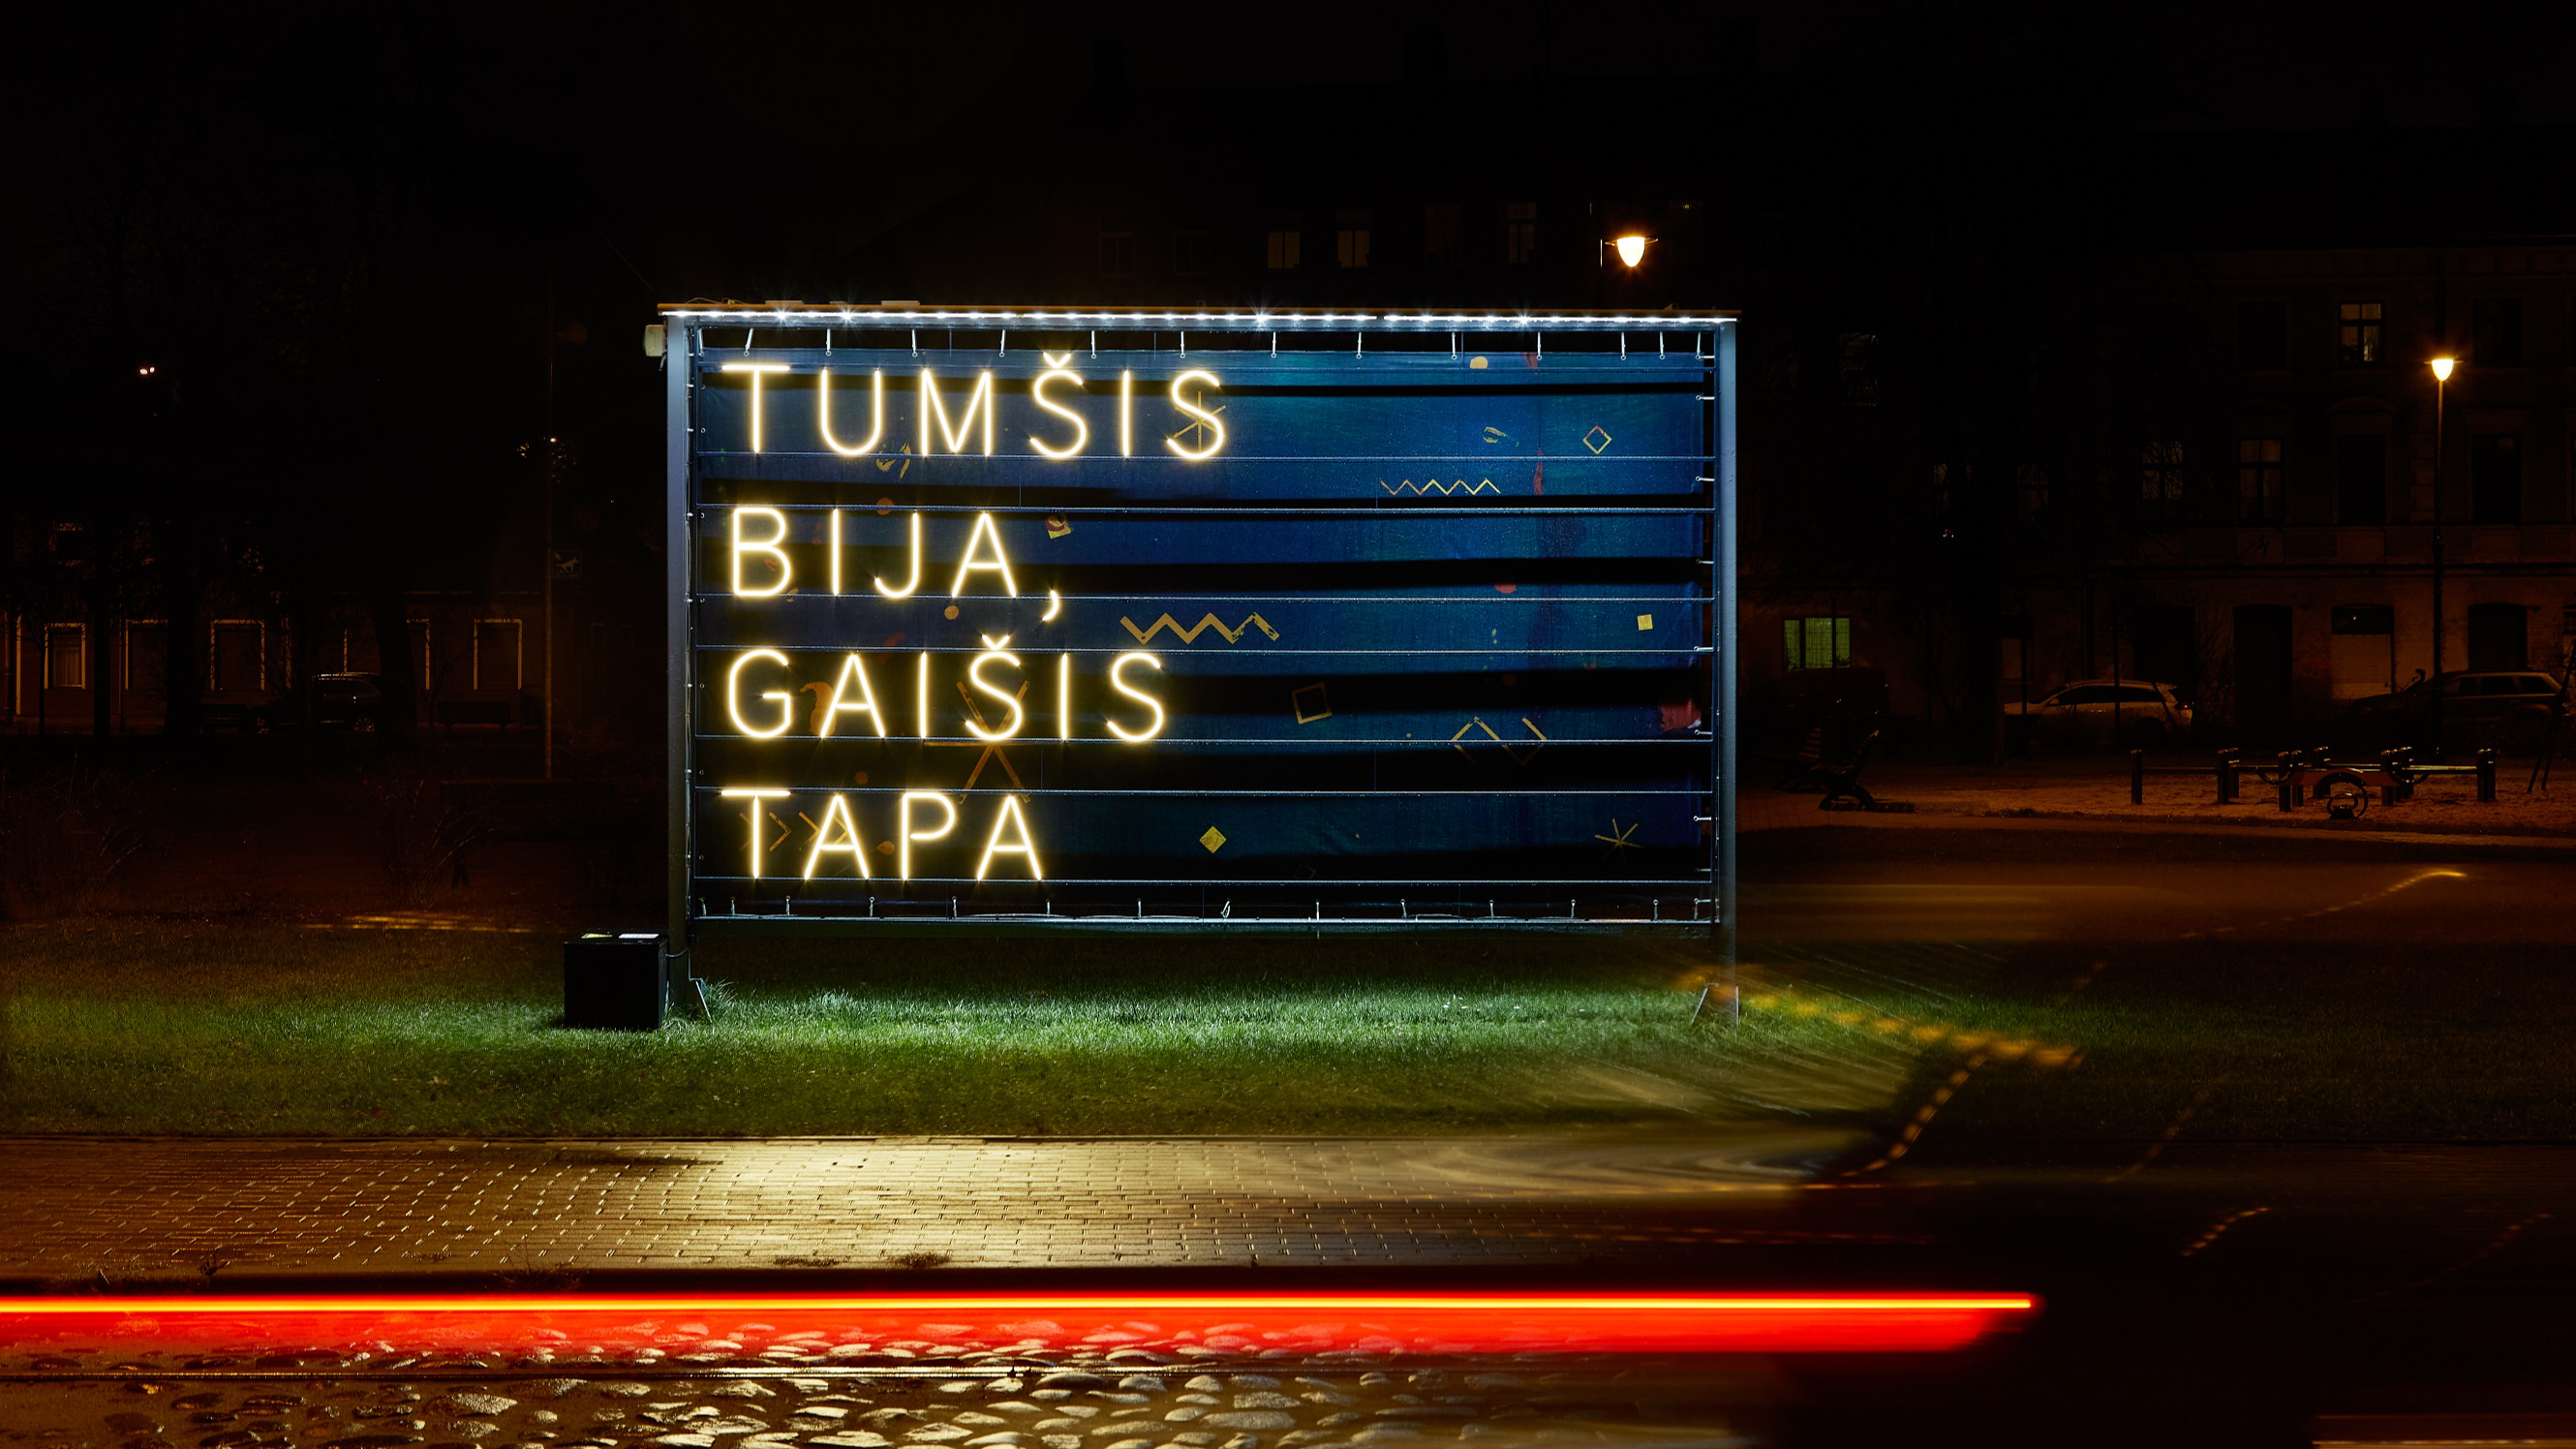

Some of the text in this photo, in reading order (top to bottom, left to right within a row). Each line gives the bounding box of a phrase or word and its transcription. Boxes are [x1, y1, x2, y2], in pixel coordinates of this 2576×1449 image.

[720, 351, 1228, 460] TUMŠIS
[729, 505, 1061, 623] BIJA,
[726, 632, 1166, 742] GAIŠIS
[720, 786, 1043, 881] TAPA
